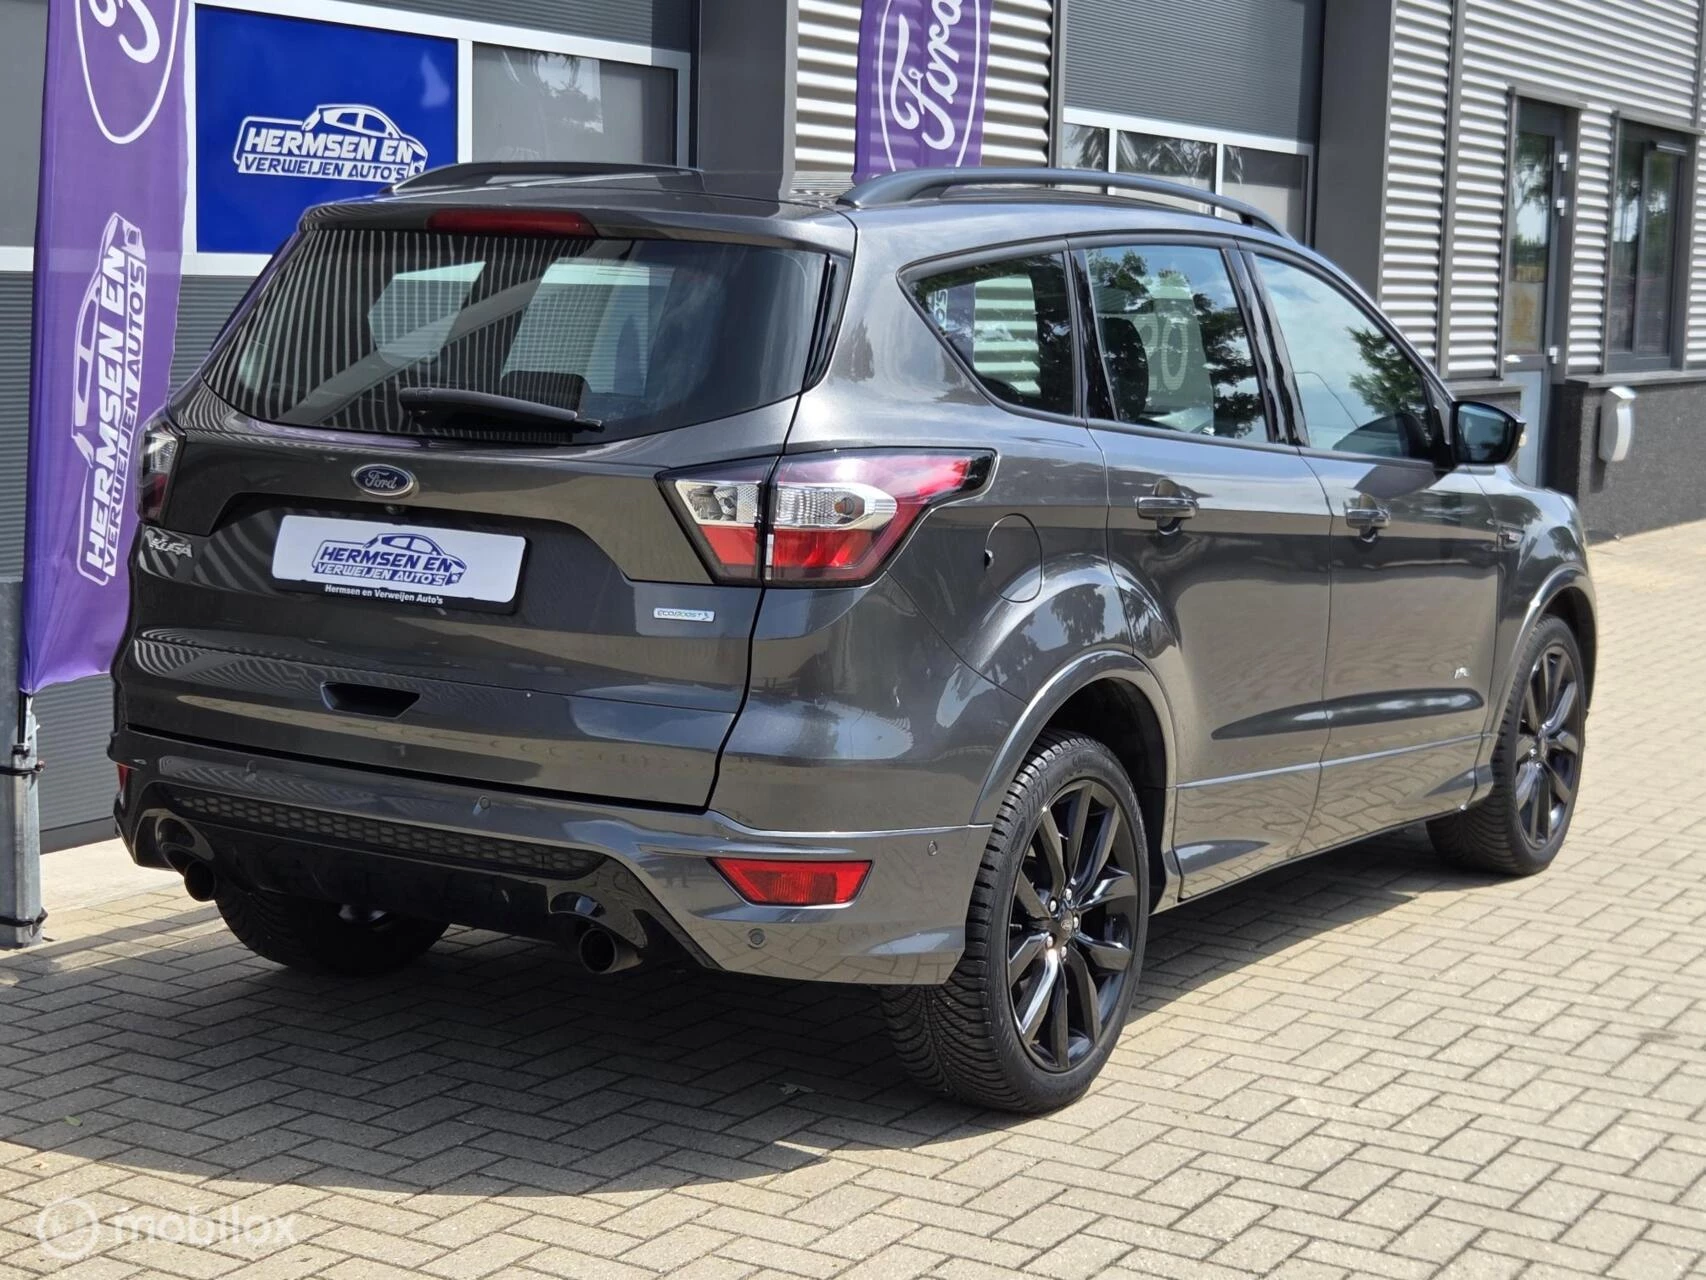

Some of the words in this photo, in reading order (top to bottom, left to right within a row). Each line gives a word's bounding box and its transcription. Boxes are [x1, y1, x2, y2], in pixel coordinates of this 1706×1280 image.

[244, 126, 377, 160] HERMSEN
[380, 139, 413, 163] EN
[244, 156, 345, 177] VERWEIJEN
[347, 164, 408, 182] AUTO'S
[101, 245, 125, 316] EN
[104, 386, 139, 568] VERWEIJEN
[126, 261, 145, 383] AUTO'S
[86, 320, 125, 569] HERMSEN
[364, 470, 398, 489] Ford
[319, 547, 422, 570] HERMSEN
[424, 556, 453, 574] EN
[317, 563, 395, 581] VERWEIJEN
[396, 571, 446, 586] AUTO'S
[324, 585, 361, 596] Hermsen
[375, 589, 415, 602] Verweijen
[416, 594, 443, 605] Auto's
